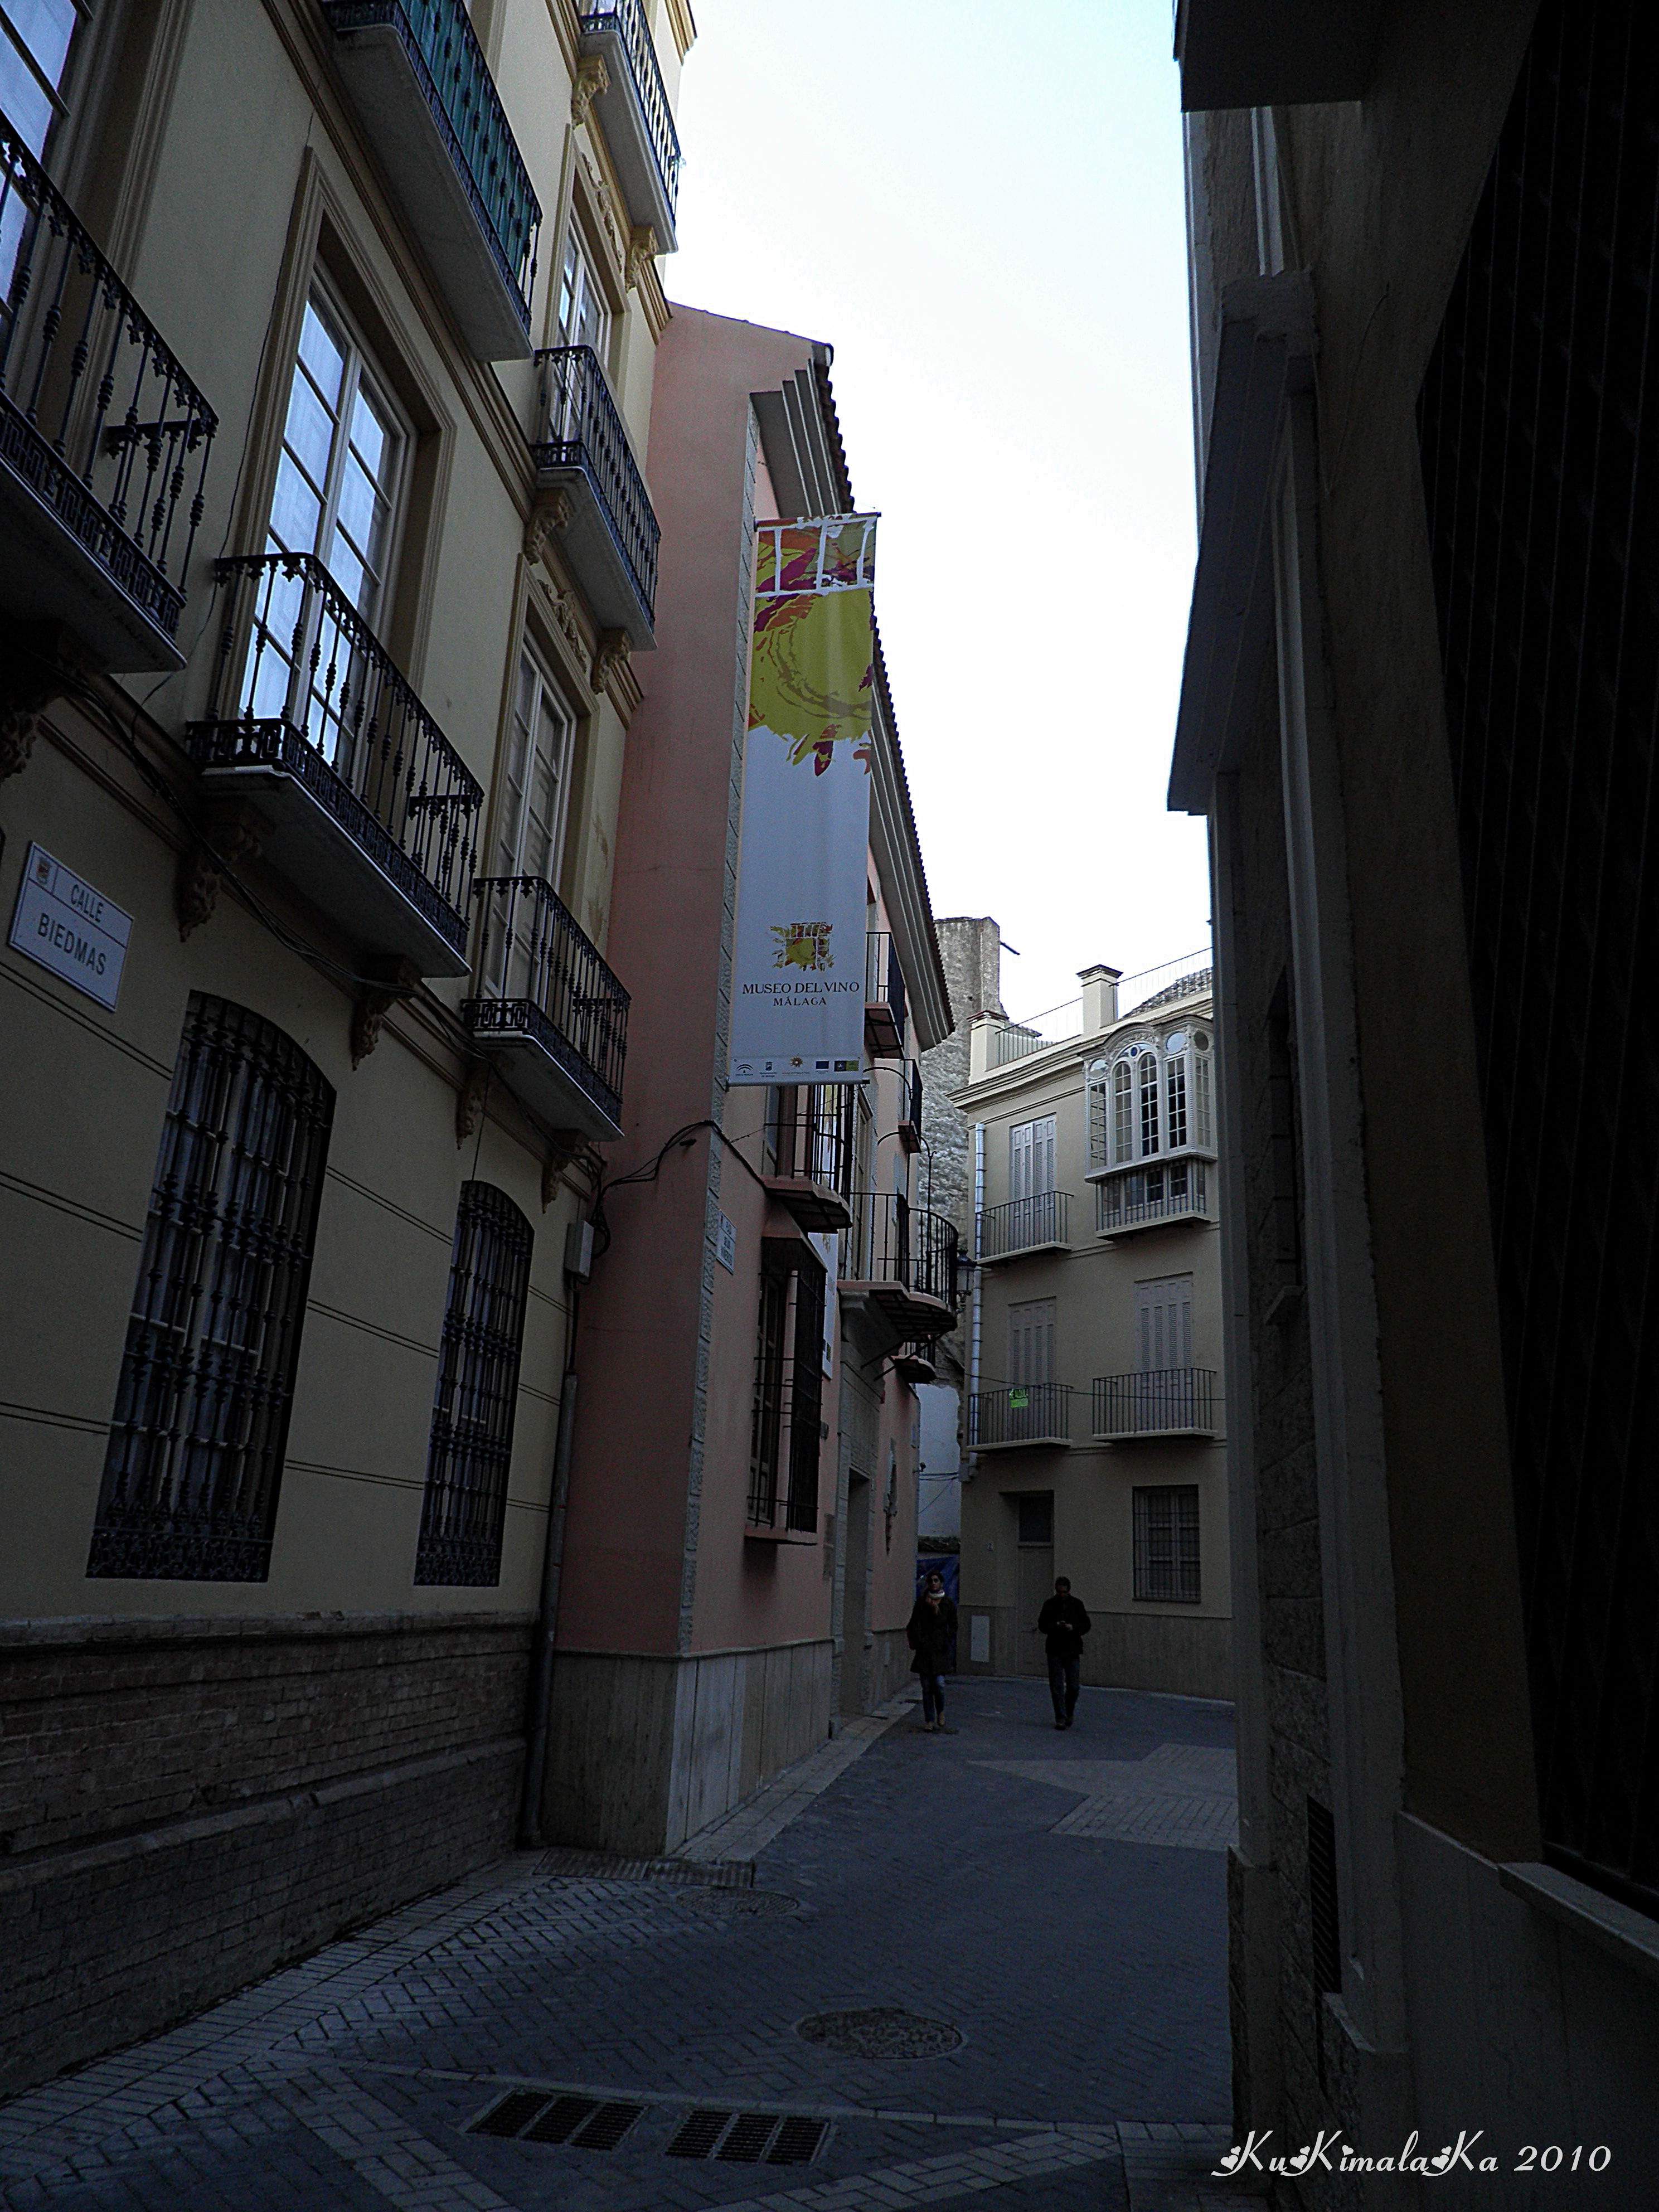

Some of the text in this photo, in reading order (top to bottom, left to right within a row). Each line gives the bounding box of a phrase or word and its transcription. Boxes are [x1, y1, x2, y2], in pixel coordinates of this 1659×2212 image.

[70, 884, 104, 923] CALLE
[37, 912, 107, 976] BIEDMAS
[742, 982, 860, 995] MUSEO DEL VINO
[773, 996, 827, 1006] MÁLAGA
